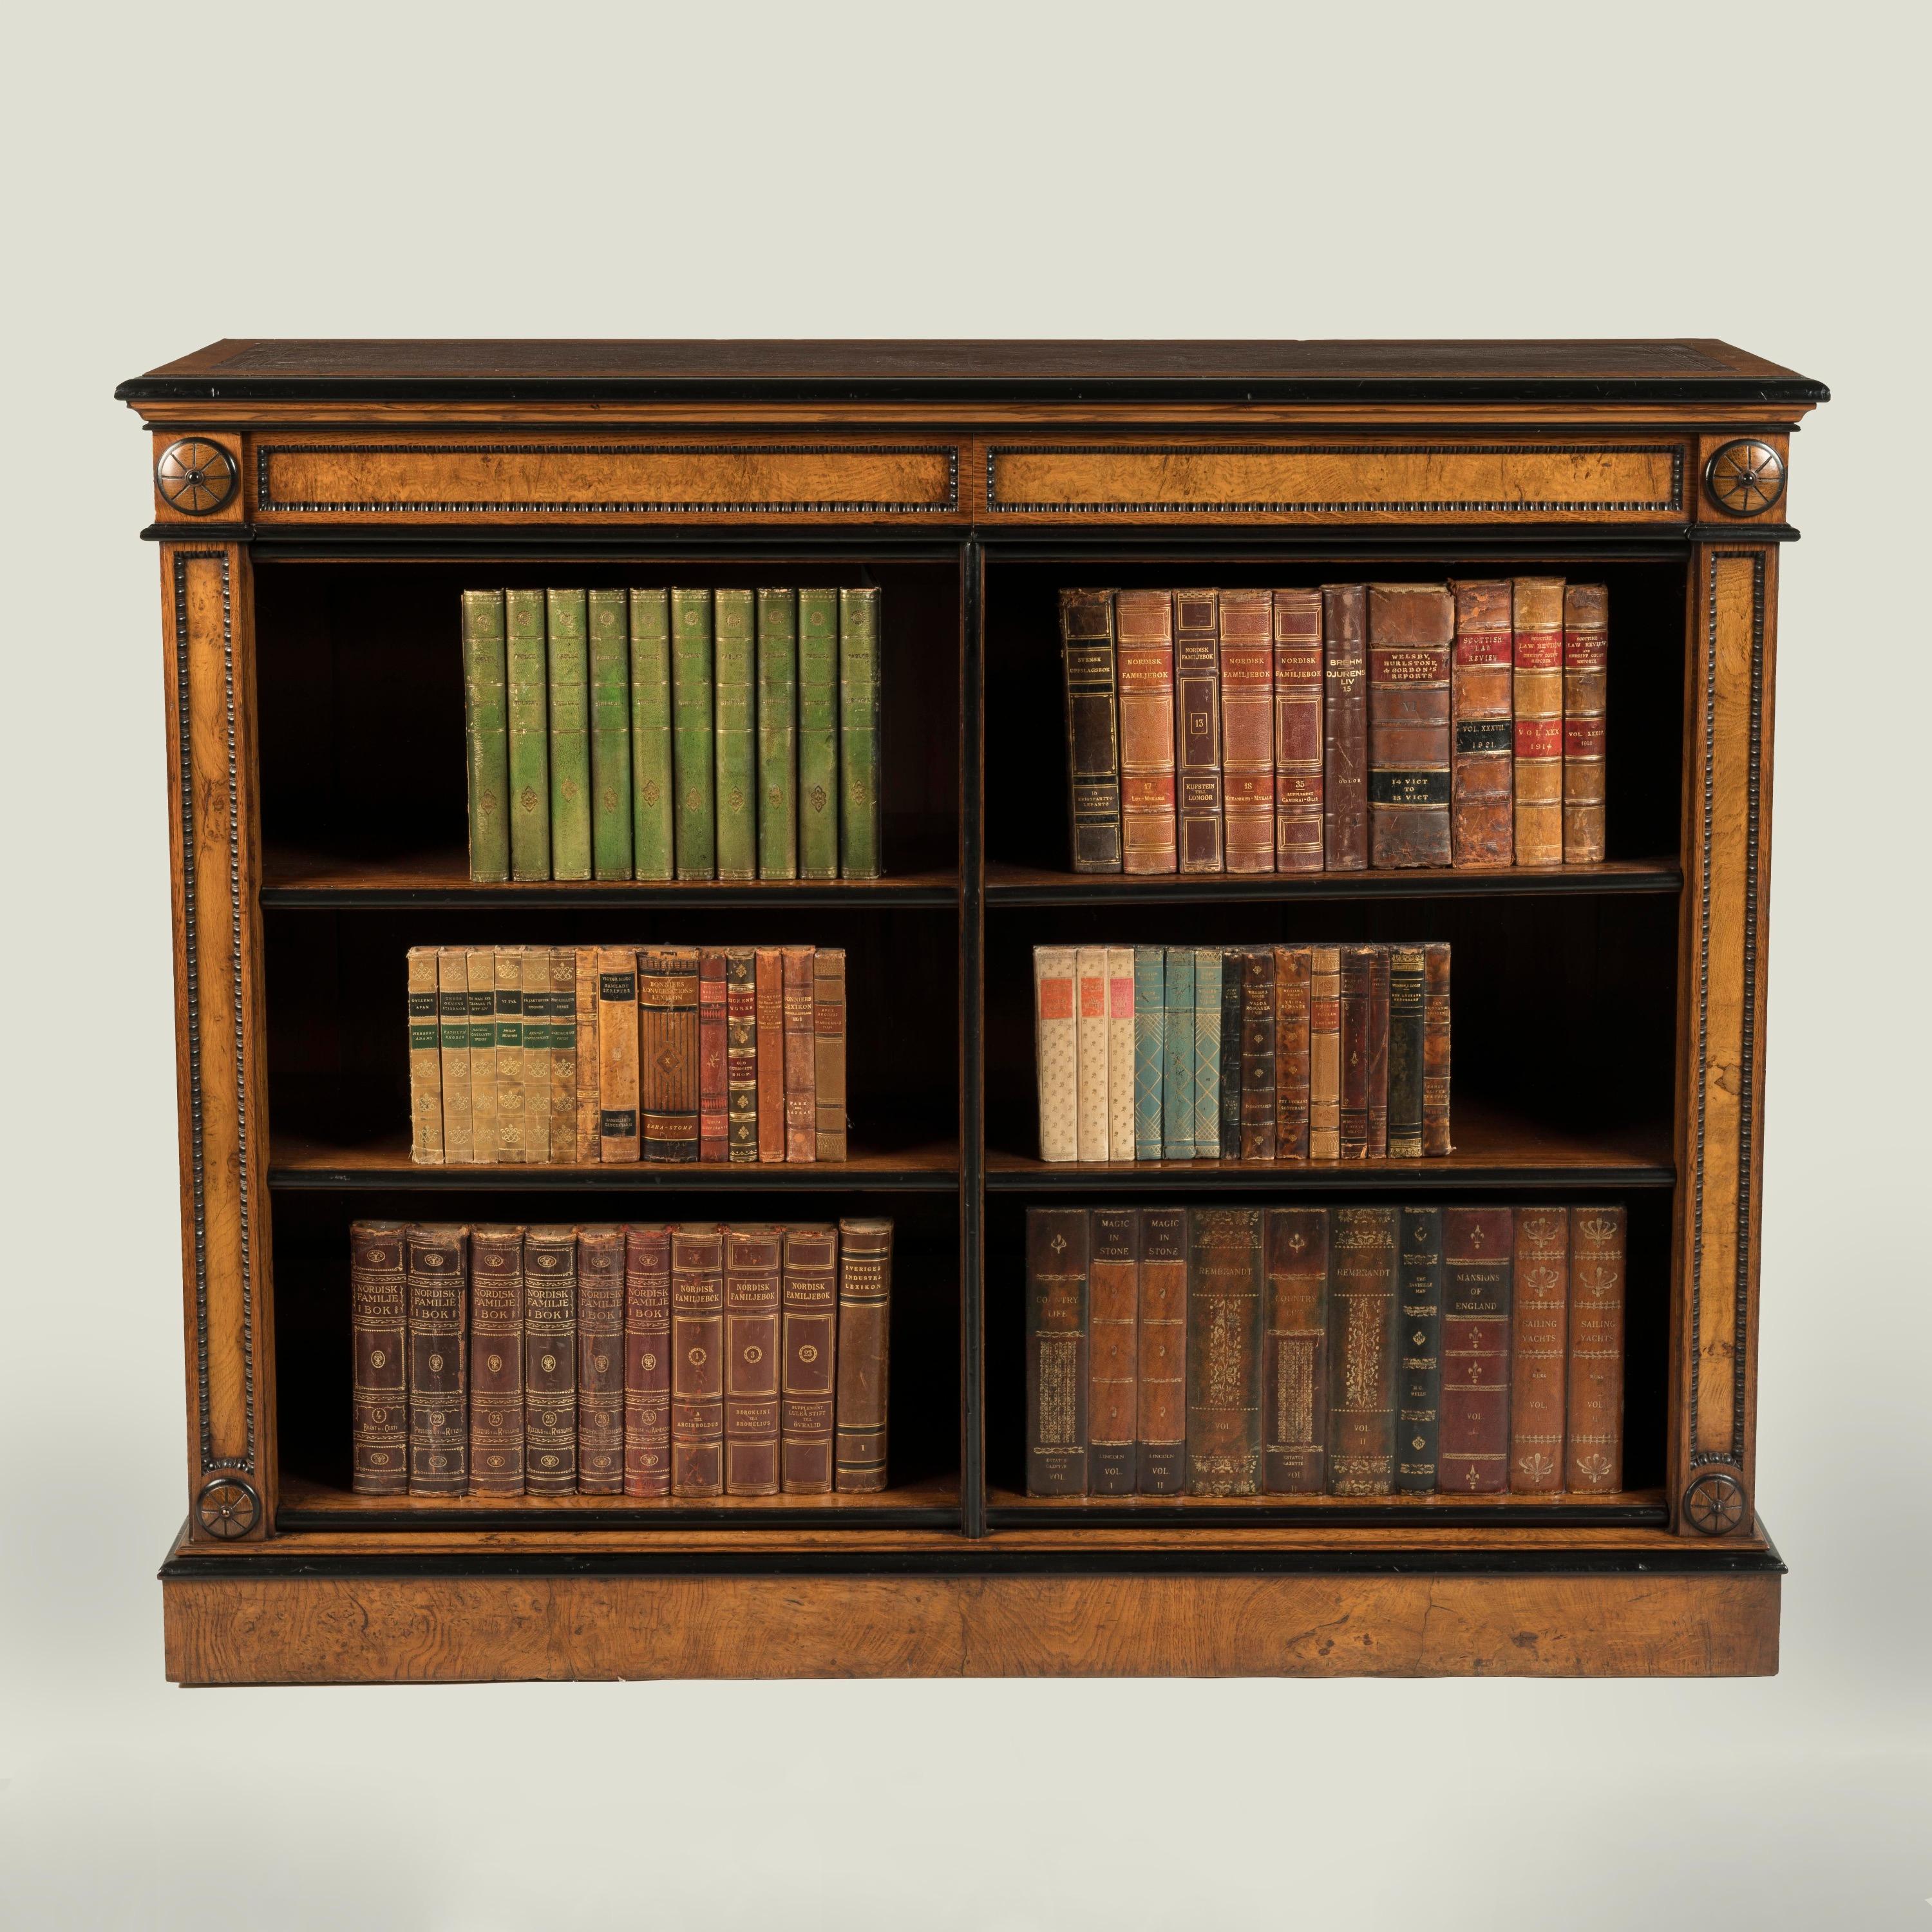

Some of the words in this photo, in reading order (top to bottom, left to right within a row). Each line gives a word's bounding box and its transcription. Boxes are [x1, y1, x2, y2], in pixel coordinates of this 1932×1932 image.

[1195, 719, 1204, 728] 13
[357, 1284, 397, 1293] NORDISK
[792, 1282, 825, 1291] NORDISK
[415, 1289, 455, 1298] NORDISK
[474, 1289, 515, 1298] NORDISK
[527, 1289, 569, 1298] NORDISK
[581, 1289, 621, 1299] NORDISK
[628, 1287, 668, 1297] NORDISK
[786, 1291, 830, 1300] FAMILJEBOK
[357, 1293, 399, 1302] FAMILJE
[415, 1297, 457, 1307] FAMILJE
[628, 1297, 669, 1306] FAMILJE
[676, 1294, 719, 1302] FAMILJEBOK
[474, 1298, 515, 1307] FAMILJE
[527, 1298, 569, 1307] FAMILJE
[582, 1298, 622, 1308] FAMILJE
[365, 1306, 391, 1314] BOK
[422, 1310, 449, 1318] BOK
[481, 1310, 508, 1319] BOK
[535, 1310, 562, 1319] BOK
[635, 1309, 662, 1318] BOK
[589, 1311, 615, 1320] BOK
[376, 1410, 382, 1419] 4
[433, 1414, 442, 1423] 22
[491, 1414, 500, 1423] 23
[598, 1415, 607, 1423] 28
[644, 1413, 654, 1421] 33
[473, 1426, 490, 1434] RETZIUS
[498, 1427, 520, 1435] RYSSLAND
[527, 1425, 543, 1434] RETZIUS
[551, 1427, 573, 1435] RYSSLAND
